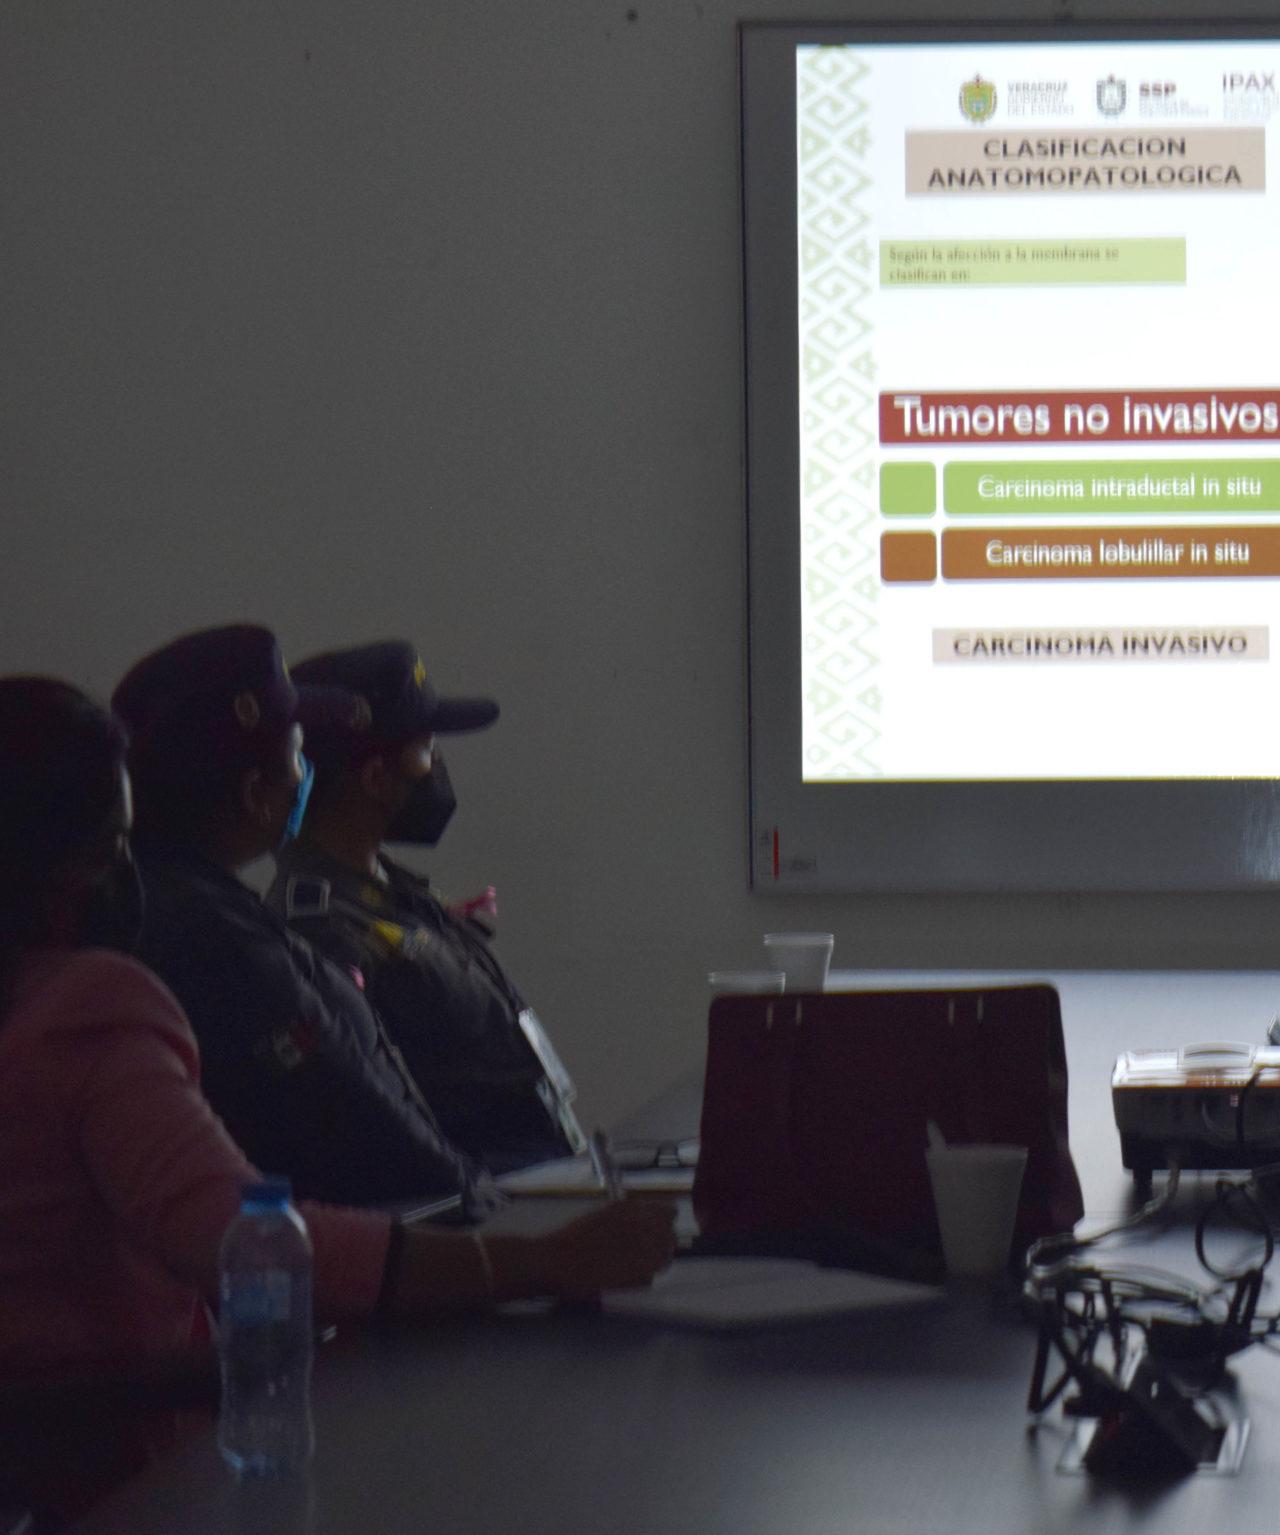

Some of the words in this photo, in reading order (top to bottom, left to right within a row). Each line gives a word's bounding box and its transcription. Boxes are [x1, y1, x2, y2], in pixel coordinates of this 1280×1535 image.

[1140, 82, 1177, 96] SSP
[1222, 72, 1276, 91] IPAX
[982, 137, 1186, 158] CLASIFICACION
[928, 165, 1242, 189] ANATOMOPATOLOGICA
[890, 247, 928, 262] Según
[932, 247, 942, 260] la
[1016, 246, 1026, 260] la
[1032, 246, 1100, 260] membrana
[1105, 248, 1120, 260] se
[890, 268, 946, 282] clasifican
[893, 394, 1051, 436] Tumores
[1064, 402, 1110, 434] no
[1123, 395, 1280, 435] invasivos
[978, 474, 1084, 498] Carcinoma
[1092, 474, 1195, 498] intraductal
[1203, 474, 1220, 496] in
[1226, 474, 1262, 496] situ
[986, 540, 1092, 566] Carcinoma
[1100, 540, 1185, 564] lobulillar
[1191, 540, 1208, 563] in
[1214, 540, 1250, 564] situ
[953, 636, 1115, 657] CARCINOMA
[1122, 635, 1249, 656] INVASIVO
